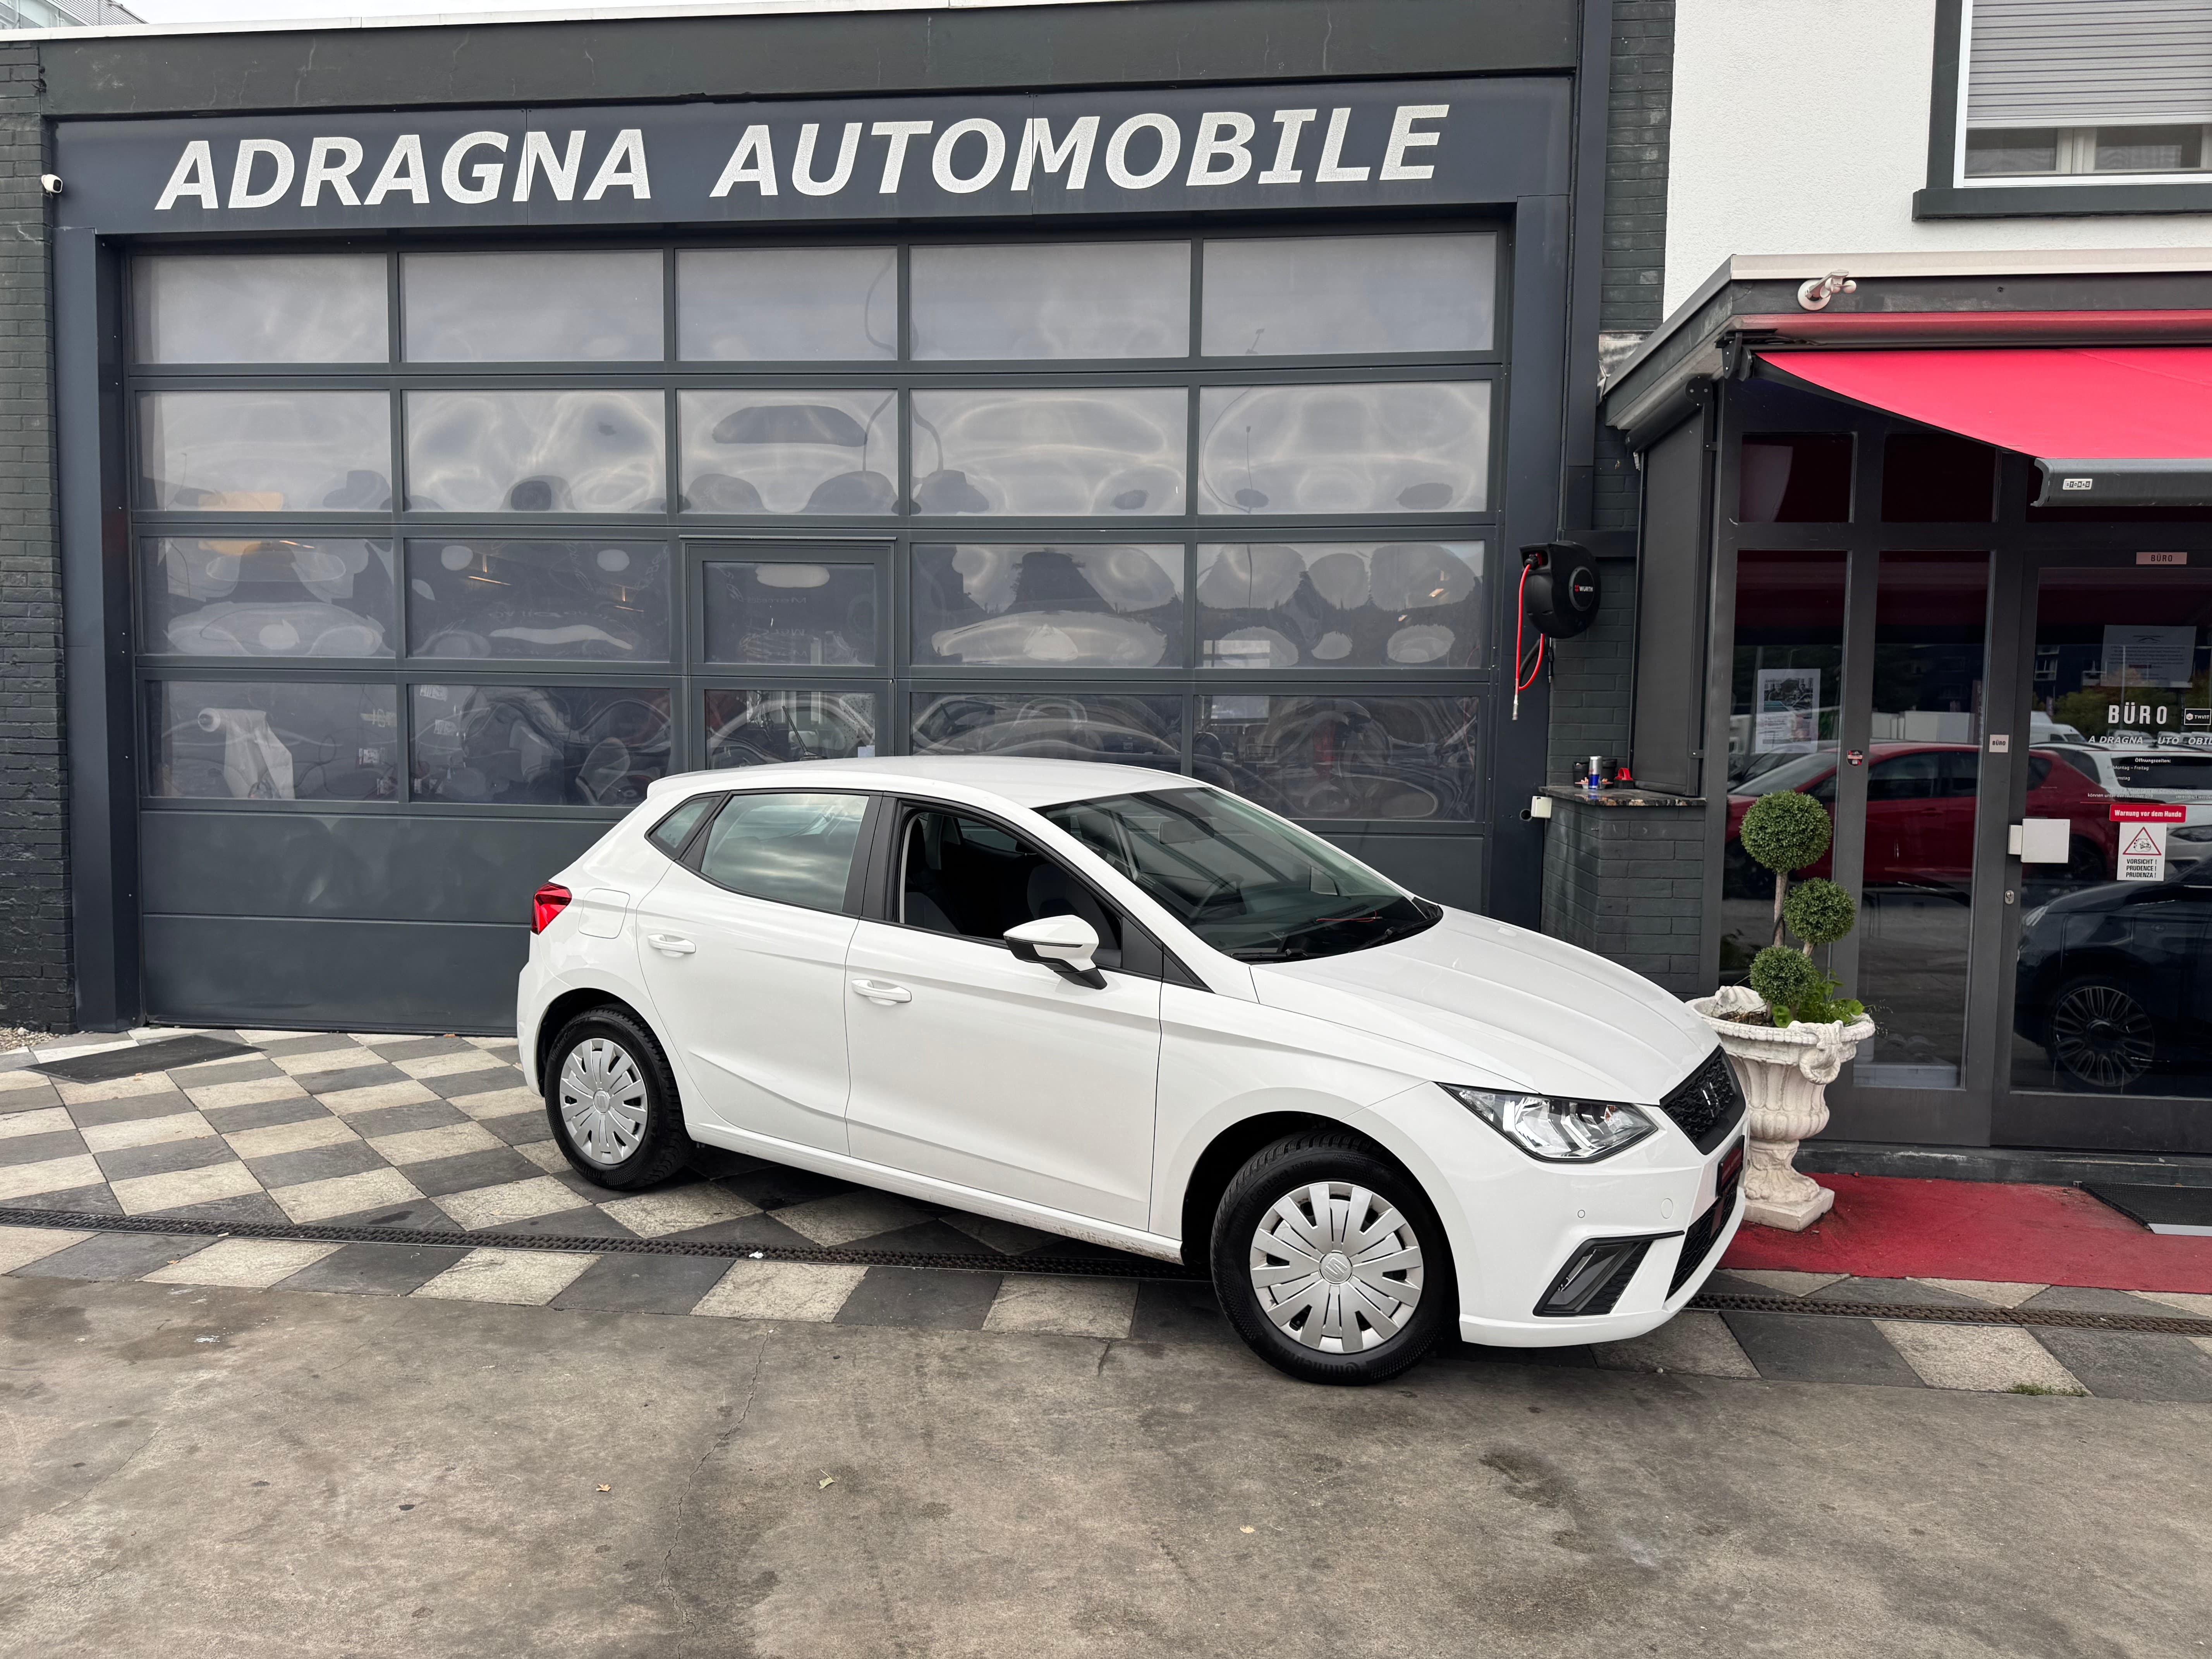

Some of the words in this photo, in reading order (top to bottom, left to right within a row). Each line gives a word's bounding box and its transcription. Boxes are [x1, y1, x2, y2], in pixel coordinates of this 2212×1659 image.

[155, 129, 651, 210] ADRAGNA
[709, 105, 1449, 197] AUTOMOBILE
[2151, 554, 2173, 563] BÜRO
[2108, 702, 2167, 725] BÜRO
